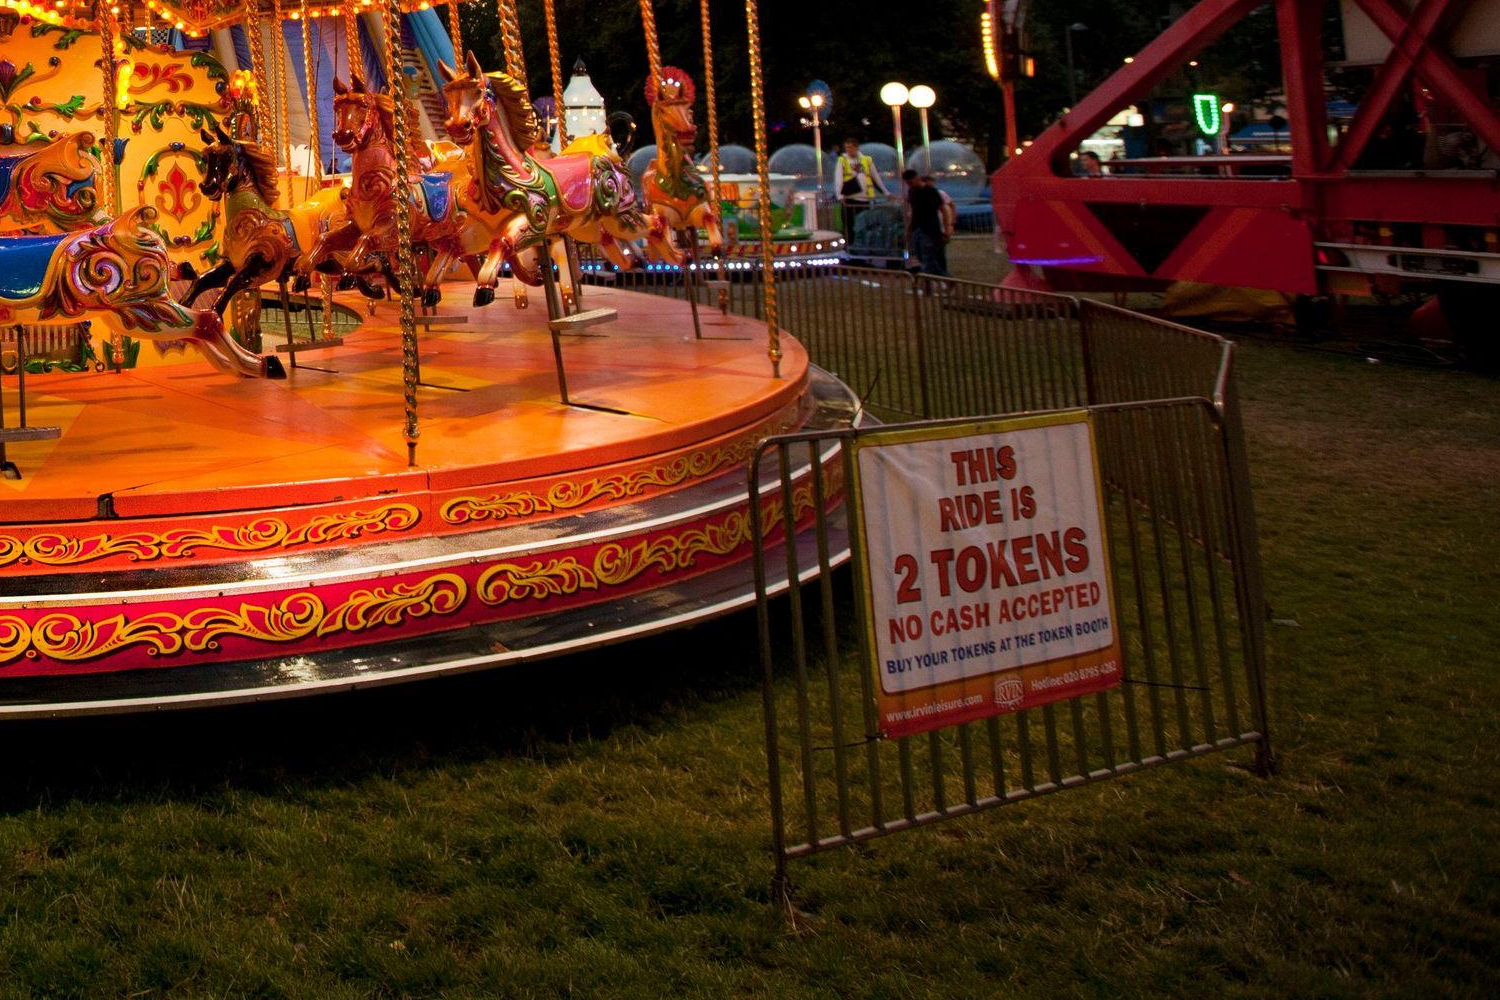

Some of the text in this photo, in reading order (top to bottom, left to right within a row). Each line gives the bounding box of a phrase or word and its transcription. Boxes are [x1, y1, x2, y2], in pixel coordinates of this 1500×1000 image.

[951, 445, 1017, 486] THIS
[939, 485, 1037, 532] RIDE IS
[894, 527, 1090, 605] 2 TOKENS
[889, 581, 1101, 645] NO CASH ACCEPTED
[886, 617, 1109, 675] BUY YOUR TOKENS AT THE TOKEN BOOTH
[886, 695, 983, 722] www.irvinleisure.com
